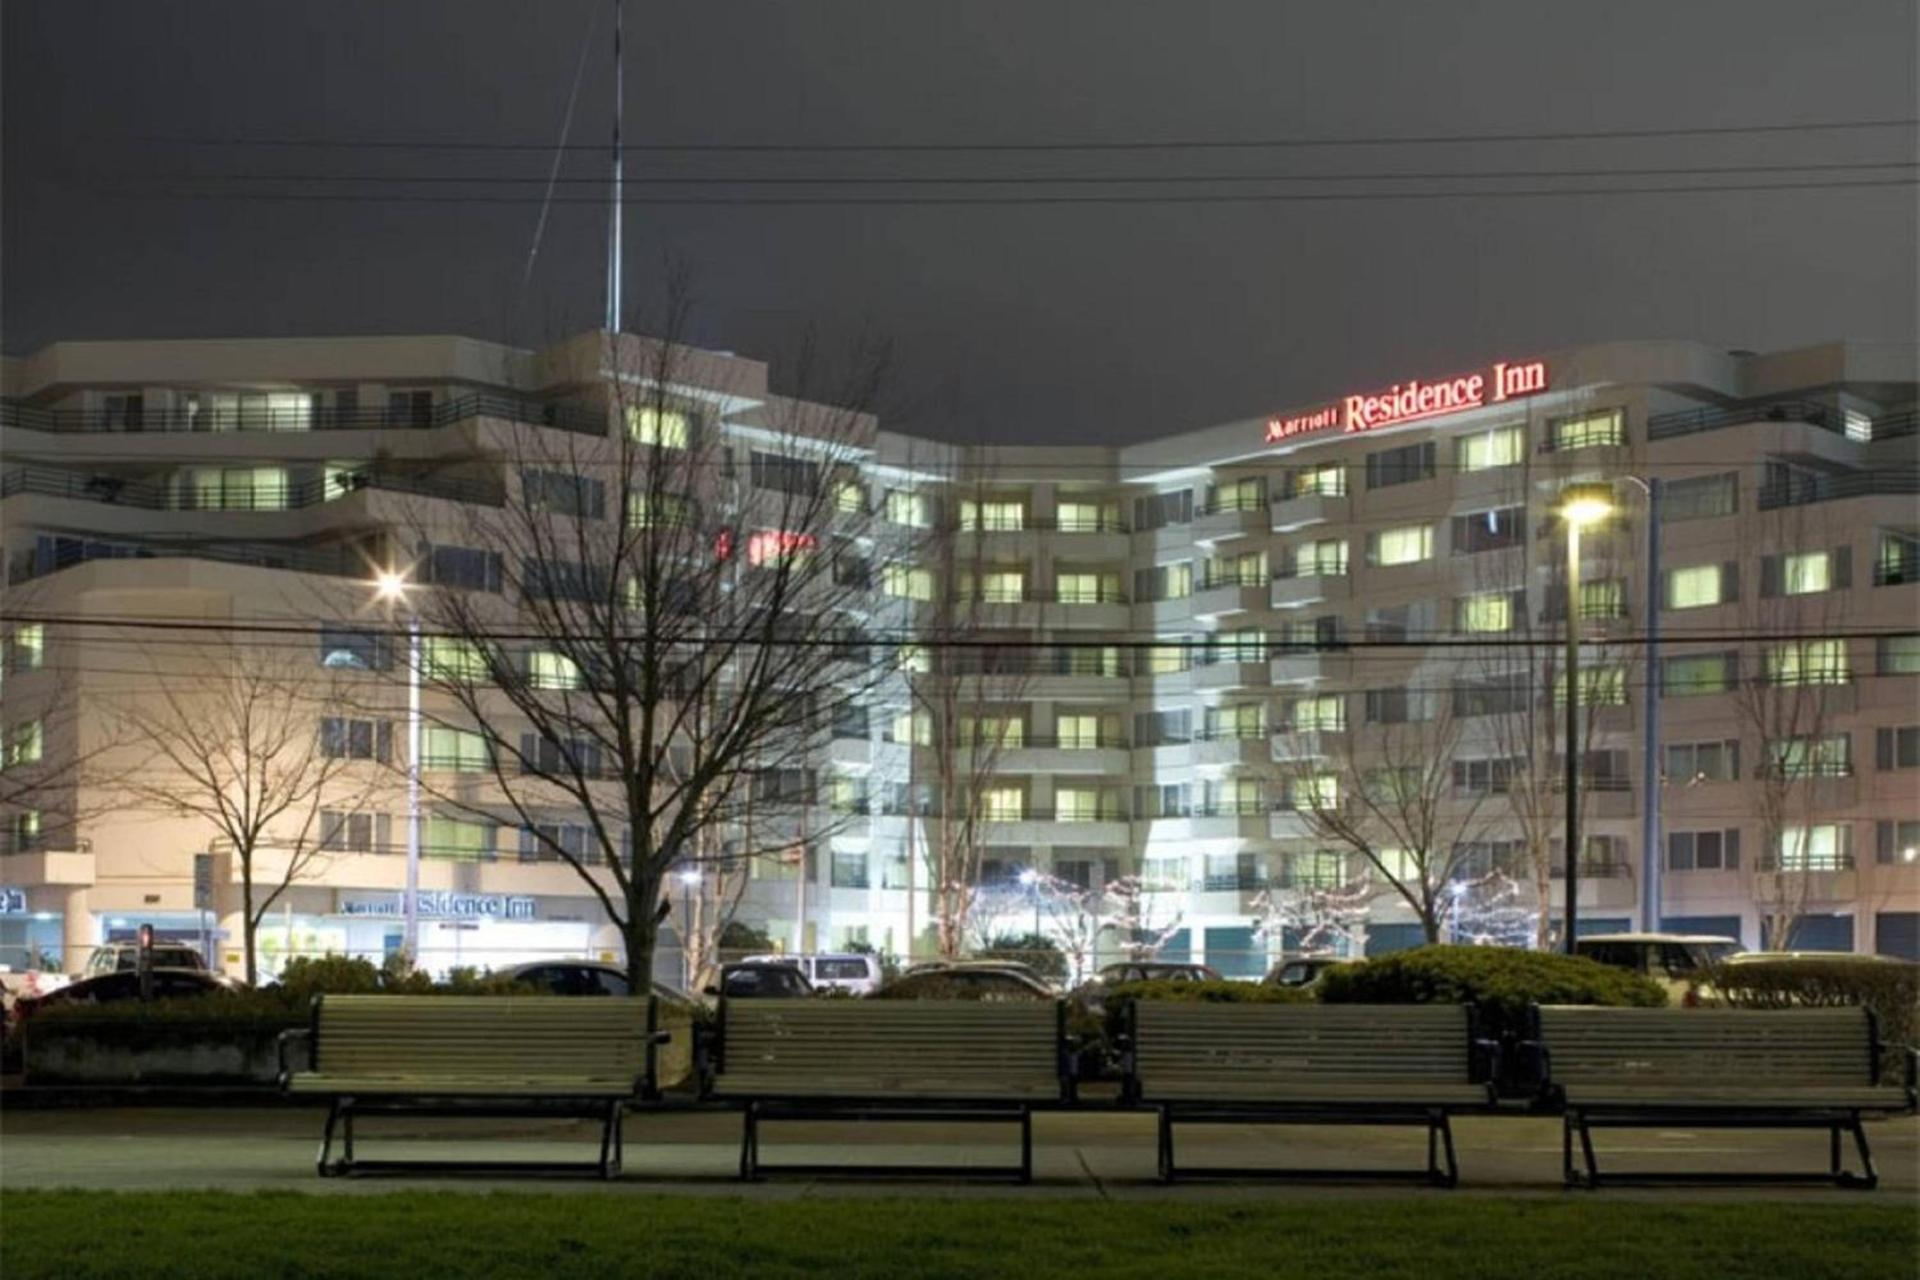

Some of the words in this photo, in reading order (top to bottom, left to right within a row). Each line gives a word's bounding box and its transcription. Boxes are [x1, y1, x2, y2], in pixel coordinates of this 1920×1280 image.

[1264, 407, 1338, 442] Marriott
[1345, 374, 1484, 433] Residence
[1493, 361, 1546, 401] Inn
[505, 896, 535, 918] Inn
